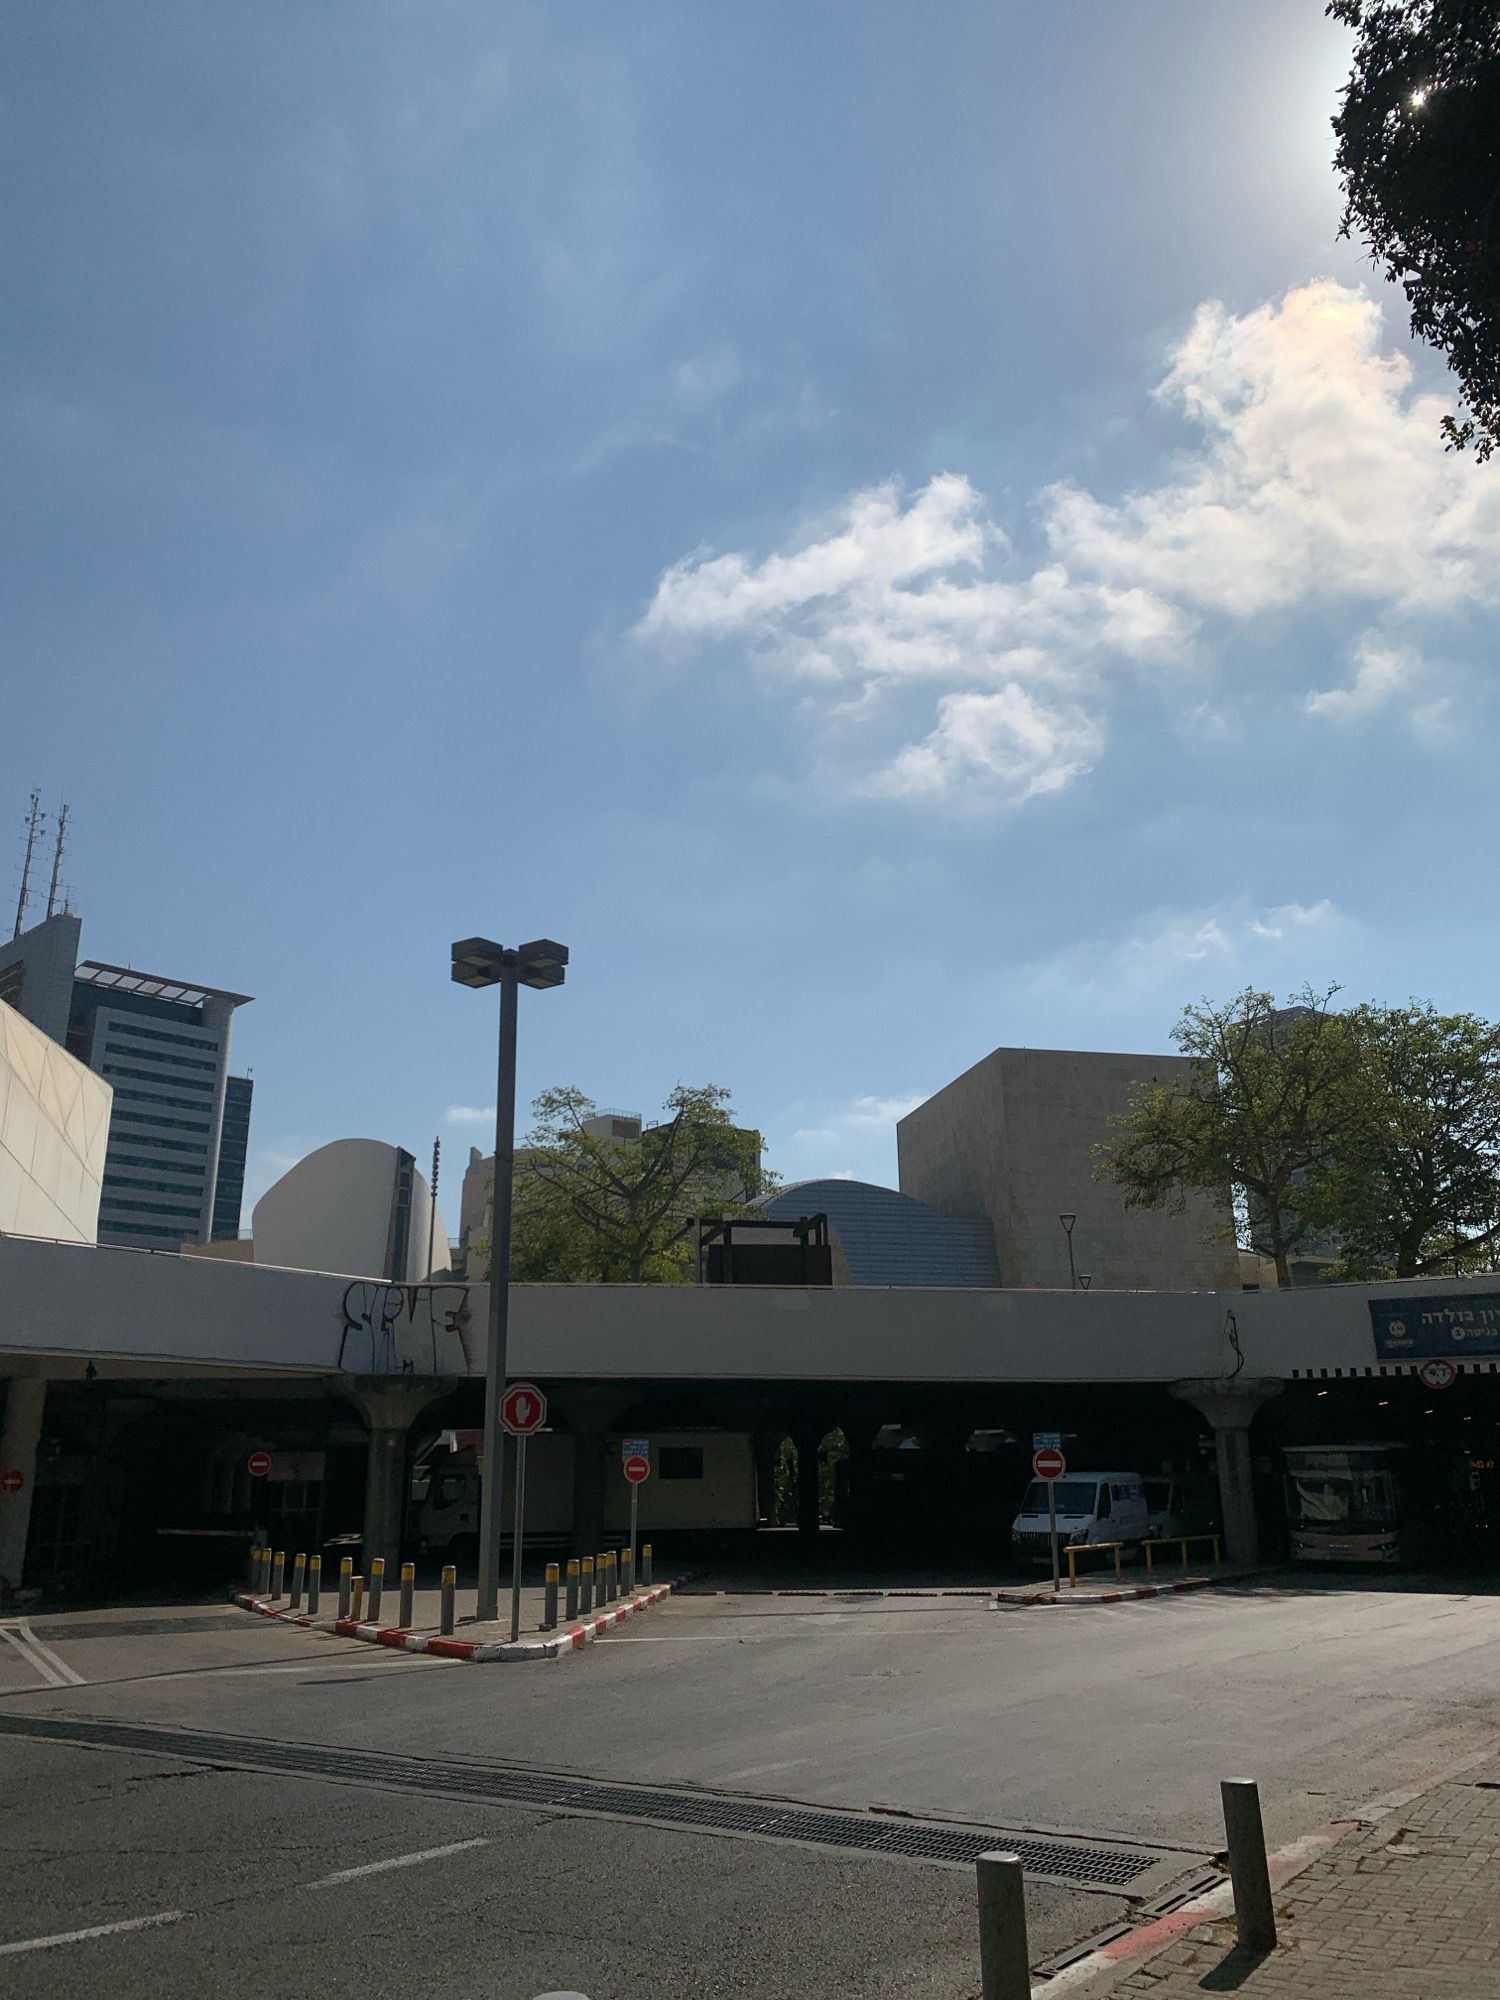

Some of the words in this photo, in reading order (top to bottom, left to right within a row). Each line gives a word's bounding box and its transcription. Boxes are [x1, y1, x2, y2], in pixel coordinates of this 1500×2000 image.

[1421, 1308, 1475, 1324] גולדה
[1480, 1309, 1500, 1325] יון
[1466, 1327, 1498, 1337] כניסה
